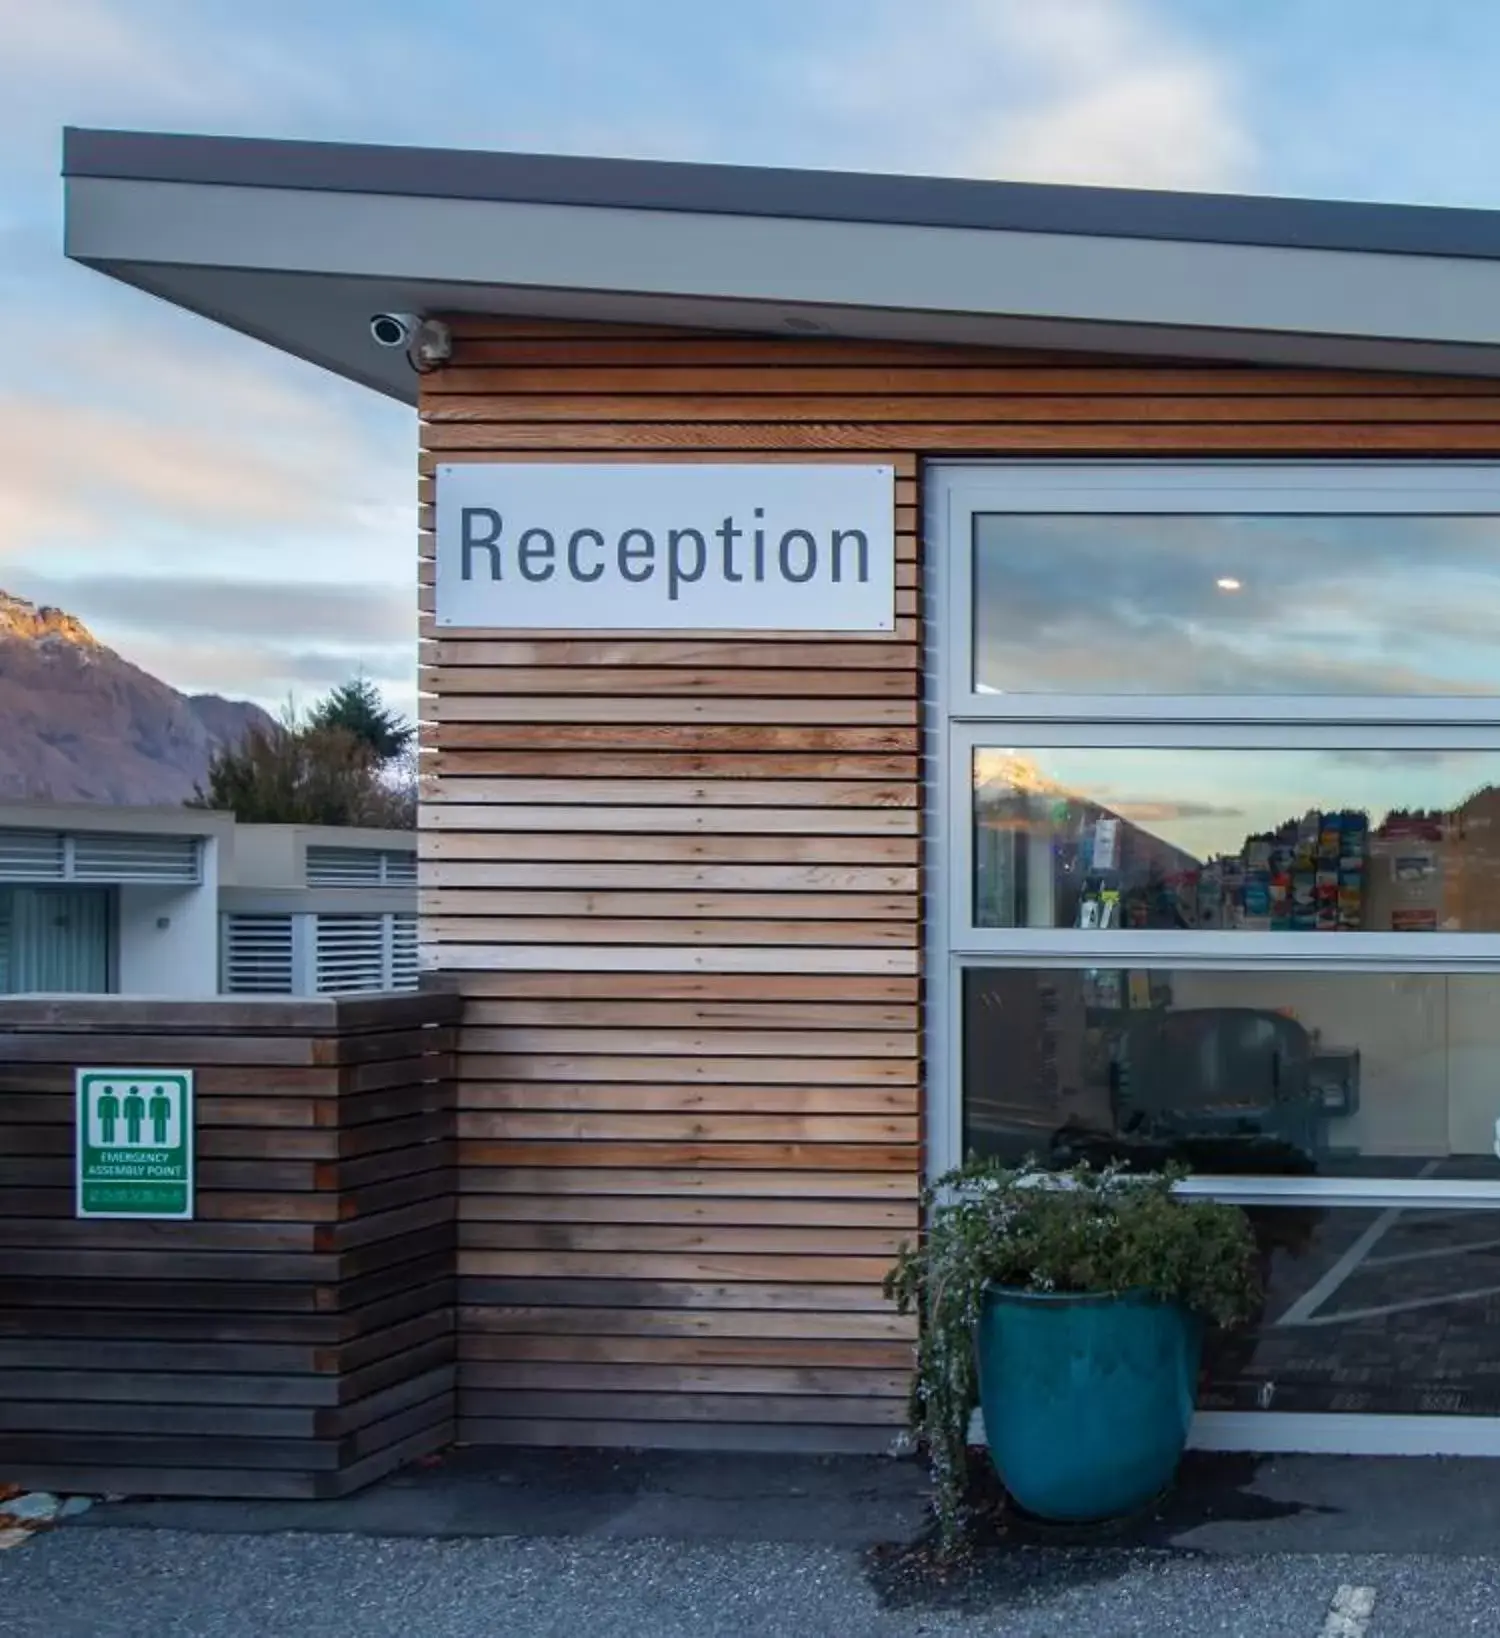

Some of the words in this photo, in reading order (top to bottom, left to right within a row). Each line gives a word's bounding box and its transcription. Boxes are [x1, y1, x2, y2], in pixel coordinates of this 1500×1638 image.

[461, 506, 870, 601] Reception
[101, 1152, 168, 1163] EMERGENCY
[89, 1165, 145, 1177] ASSEMBLY
[148, 1166, 182, 1177] POINT
